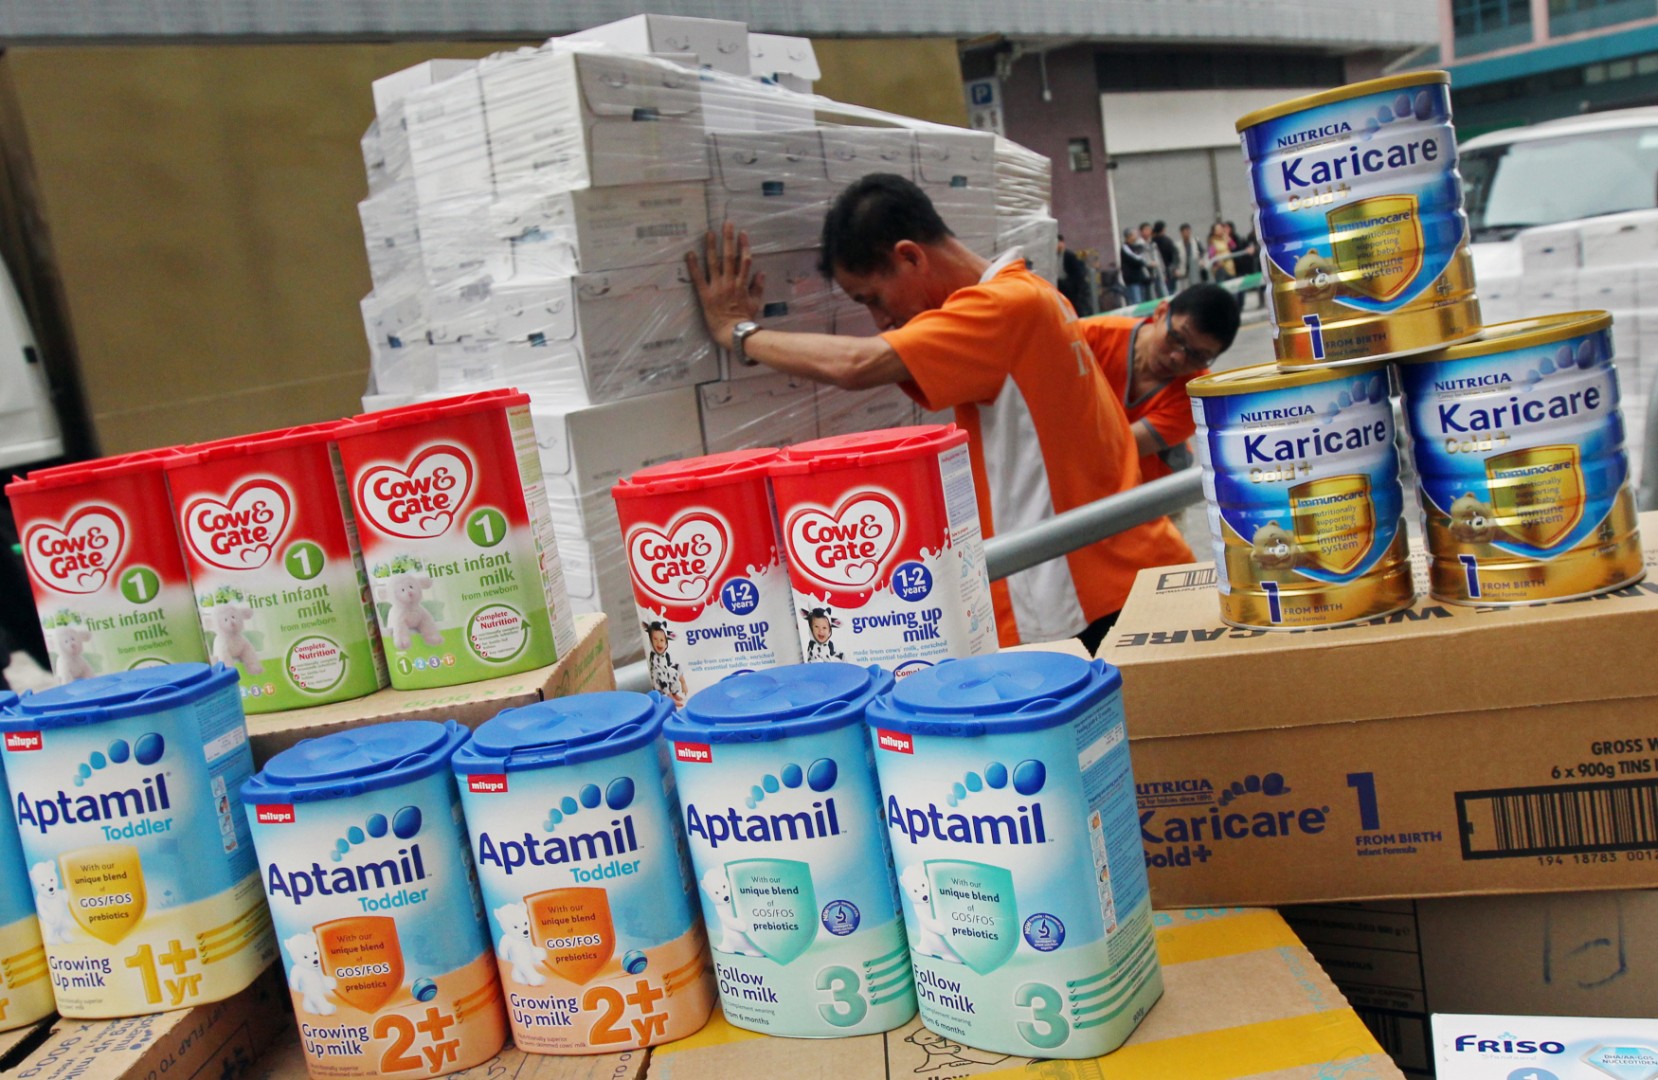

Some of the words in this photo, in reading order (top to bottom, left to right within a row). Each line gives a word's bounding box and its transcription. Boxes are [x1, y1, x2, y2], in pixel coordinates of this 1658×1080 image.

[1277, 121, 1352, 147] NUTRICIA
[1281, 138, 1438, 191] Karicare
[1337, 211, 1411, 232] Immunocare
[1358, 256, 1403, 270] immune
[1362, 265, 1403, 281] system
[1302, 313, 1325, 360] 1
[1326, 337, 1353, 348] FROM
[1356, 333, 1387, 344] BIRTH
[1434, 372, 1512, 392] NUTRICIA
[1240, 405, 1315, 423] NUTRICIA
[1438, 386, 1600, 434] Karicare
[1244, 420, 1386, 464] Karicare
[1494, 460, 1572, 480] Immunocare
[373, 477, 430, 501] Cow
[433, 466, 456, 491] &
[387, 493, 450, 523] Gate
[1297, 489, 1365, 508] Immunocare
[197, 509, 251, 533] Cow
[252, 500, 274, 524] &
[1516, 505, 1565, 519] immune
[1520, 514, 1564, 529] system
[475, 514, 494, 543] 1
[802, 520, 858, 544] Cow
[860, 514, 883, 539] &
[37, 535, 86, 557] Cow
[87, 527, 108, 550] &
[210, 526, 269, 555] Gate
[640, 539, 689, 561] Cow
[691, 533, 712, 556] &
[1317, 532, 1358, 546] immune
[1321, 541, 1359, 556] system
[292, 548, 312, 576] 1
[428, 562, 460, 578] first
[464, 551, 512, 573] infant
[815, 541, 876, 568] Gate
[50, 551, 104, 579] Gate
[651, 558, 707, 585] Gate
[128, 572, 147, 600] 1
[479, 569, 515, 587] milk
[897, 567, 926, 587] 1-2
[1457, 553, 1482, 599] 1
[1482, 581, 1511, 590] FROM
[1514, 578, 1546, 588] BIRTH
[249, 593, 278, 609] first
[282, 583, 330, 604] infant
[483, 583, 519, 597] newborn
[726, 582, 753, 602] 1-2
[902, 585, 927, 597] years
[297, 600, 333, 619] milk
[731, 601, 754, 611] years
[1260, 580, 1282, 624] 1
[1284, 606, 1311, 616] FROM
[1314, 603, 1343, 613] BIRTH
[86, 616, 116, 632] first
[119, 608, 165, 627] infant
[301, 616, 336, 630] newborn
[475, 610, 508, 623] Complete
[480, 616, 518, 629] Nutrition
[852, 610, 918, 633] growing
[921, 608, 943, 626] up
[134, 623, 169, 641] milk
[686, 623, 747, 646] growing
[750, 621, 769, 637] up
[903, 623, 941, 642] milk
[734, 635, 768, 653] milk
[299, 648, 336, 661] Nutrition
[8, 734, 38, 749] milupa
[880, 736, 910, 750] milupa
[1591, 739, 1643, 756] GROSS
[678, 748, 708, 759] milupa
[1551, 765, 1561, 779] 6
[1578, 762, 1615, 778] 900g
[1618, 759, 1651, 774] TINS
[471, 782, 504, 791] milupa
[1136, 779, 1213, 795] UTRICIA
[18, 772, 170, 834] Aptamil
[1346, 772, 1380, 831] 1
[259, 812, 291, 822] milupa
[686, 797, 840, 848] Aptamil
[888, 795, 1046, 845] Aptamil
[101, 818, 173, 841] Toddler
[1355, 834, 1395, 846] FROM
[1399, 831, 1442, 844] BIRTH
[479, 815, 637, 875] Aptamil
[1357, 847, 1381, 856] Infant
[1383, 846, 1417, 855] Formula
[80, 863, 99, 872] With
[1538, 856, 1563, 866] 194
[1573, 852, 1617, 864] 18783
[75, 873, 102, 885] unique
[103, 871, 128, 883] blend
[268, 843, 426, 905] Aptamil
[570, 860, 641, 884] Toddler
[80, 893, 132, 908] GOS/FOS
[357, 888, 429, 912] Toddler
[739, 887, 771, 896] unique
[772, 886, 799, 895] blend
[939, 888, 970, 900] unique
[972, 891, 1000, 904] blend
[88, 910, 130, 924] prebiotics
[542, 916, 570, 926] unique
[571, 913, 596, 923] blend
[752, 909, 794, 918] GOS/FOS
[951, 912, 995, 927] GOS/FOS
[753, 922, 799, 932] prebiotics
[952, 926, 999, 941] prebiotics
[331, 945, 359, 955] unique
[360, 942, 385, 952] blend
[547, 935, 600, 949] GOS/FOS
[50, 956, 112, 974] Growing
[555, 952, 598, 964] prebiotics
[124, 939, 197, 1005] 1+
[336, 963, 390, 978] GOS/FOS
[717, 963, 763, 986] Follow
[914, 964, 961, 994] Follow
[53, 973, 69, 991] Up
[72, 973, 106, 988] milk
[164, 973, 203, 1006] yr
[345, 980, 387, 993] prebiotics
[720, 980, 740, 1000] On
[743, 987, 778, 1004] milk
[510, 993, 579, 1013] Growing
[815, 965, 868, 1028] 3
[916, 982, 937, 1004] On
[939, 991, 976, 1015] milk
[513, 1010, 533, 1028] Up
[536, 1011, 572, 1026] milk
[582, 979, 664, 1046] 2+
[1015, 981, 1071, 1049] 3
[302, 1024, 370, 1042] Growing
[631, 1012, 669, 1047] yr
[305, 1040, 324, 1058] Up
[328, 1040, 363, 1055] milk
[373, 1007, 454, 1073] 2+
[422, 1039, 460, 1073] yr
